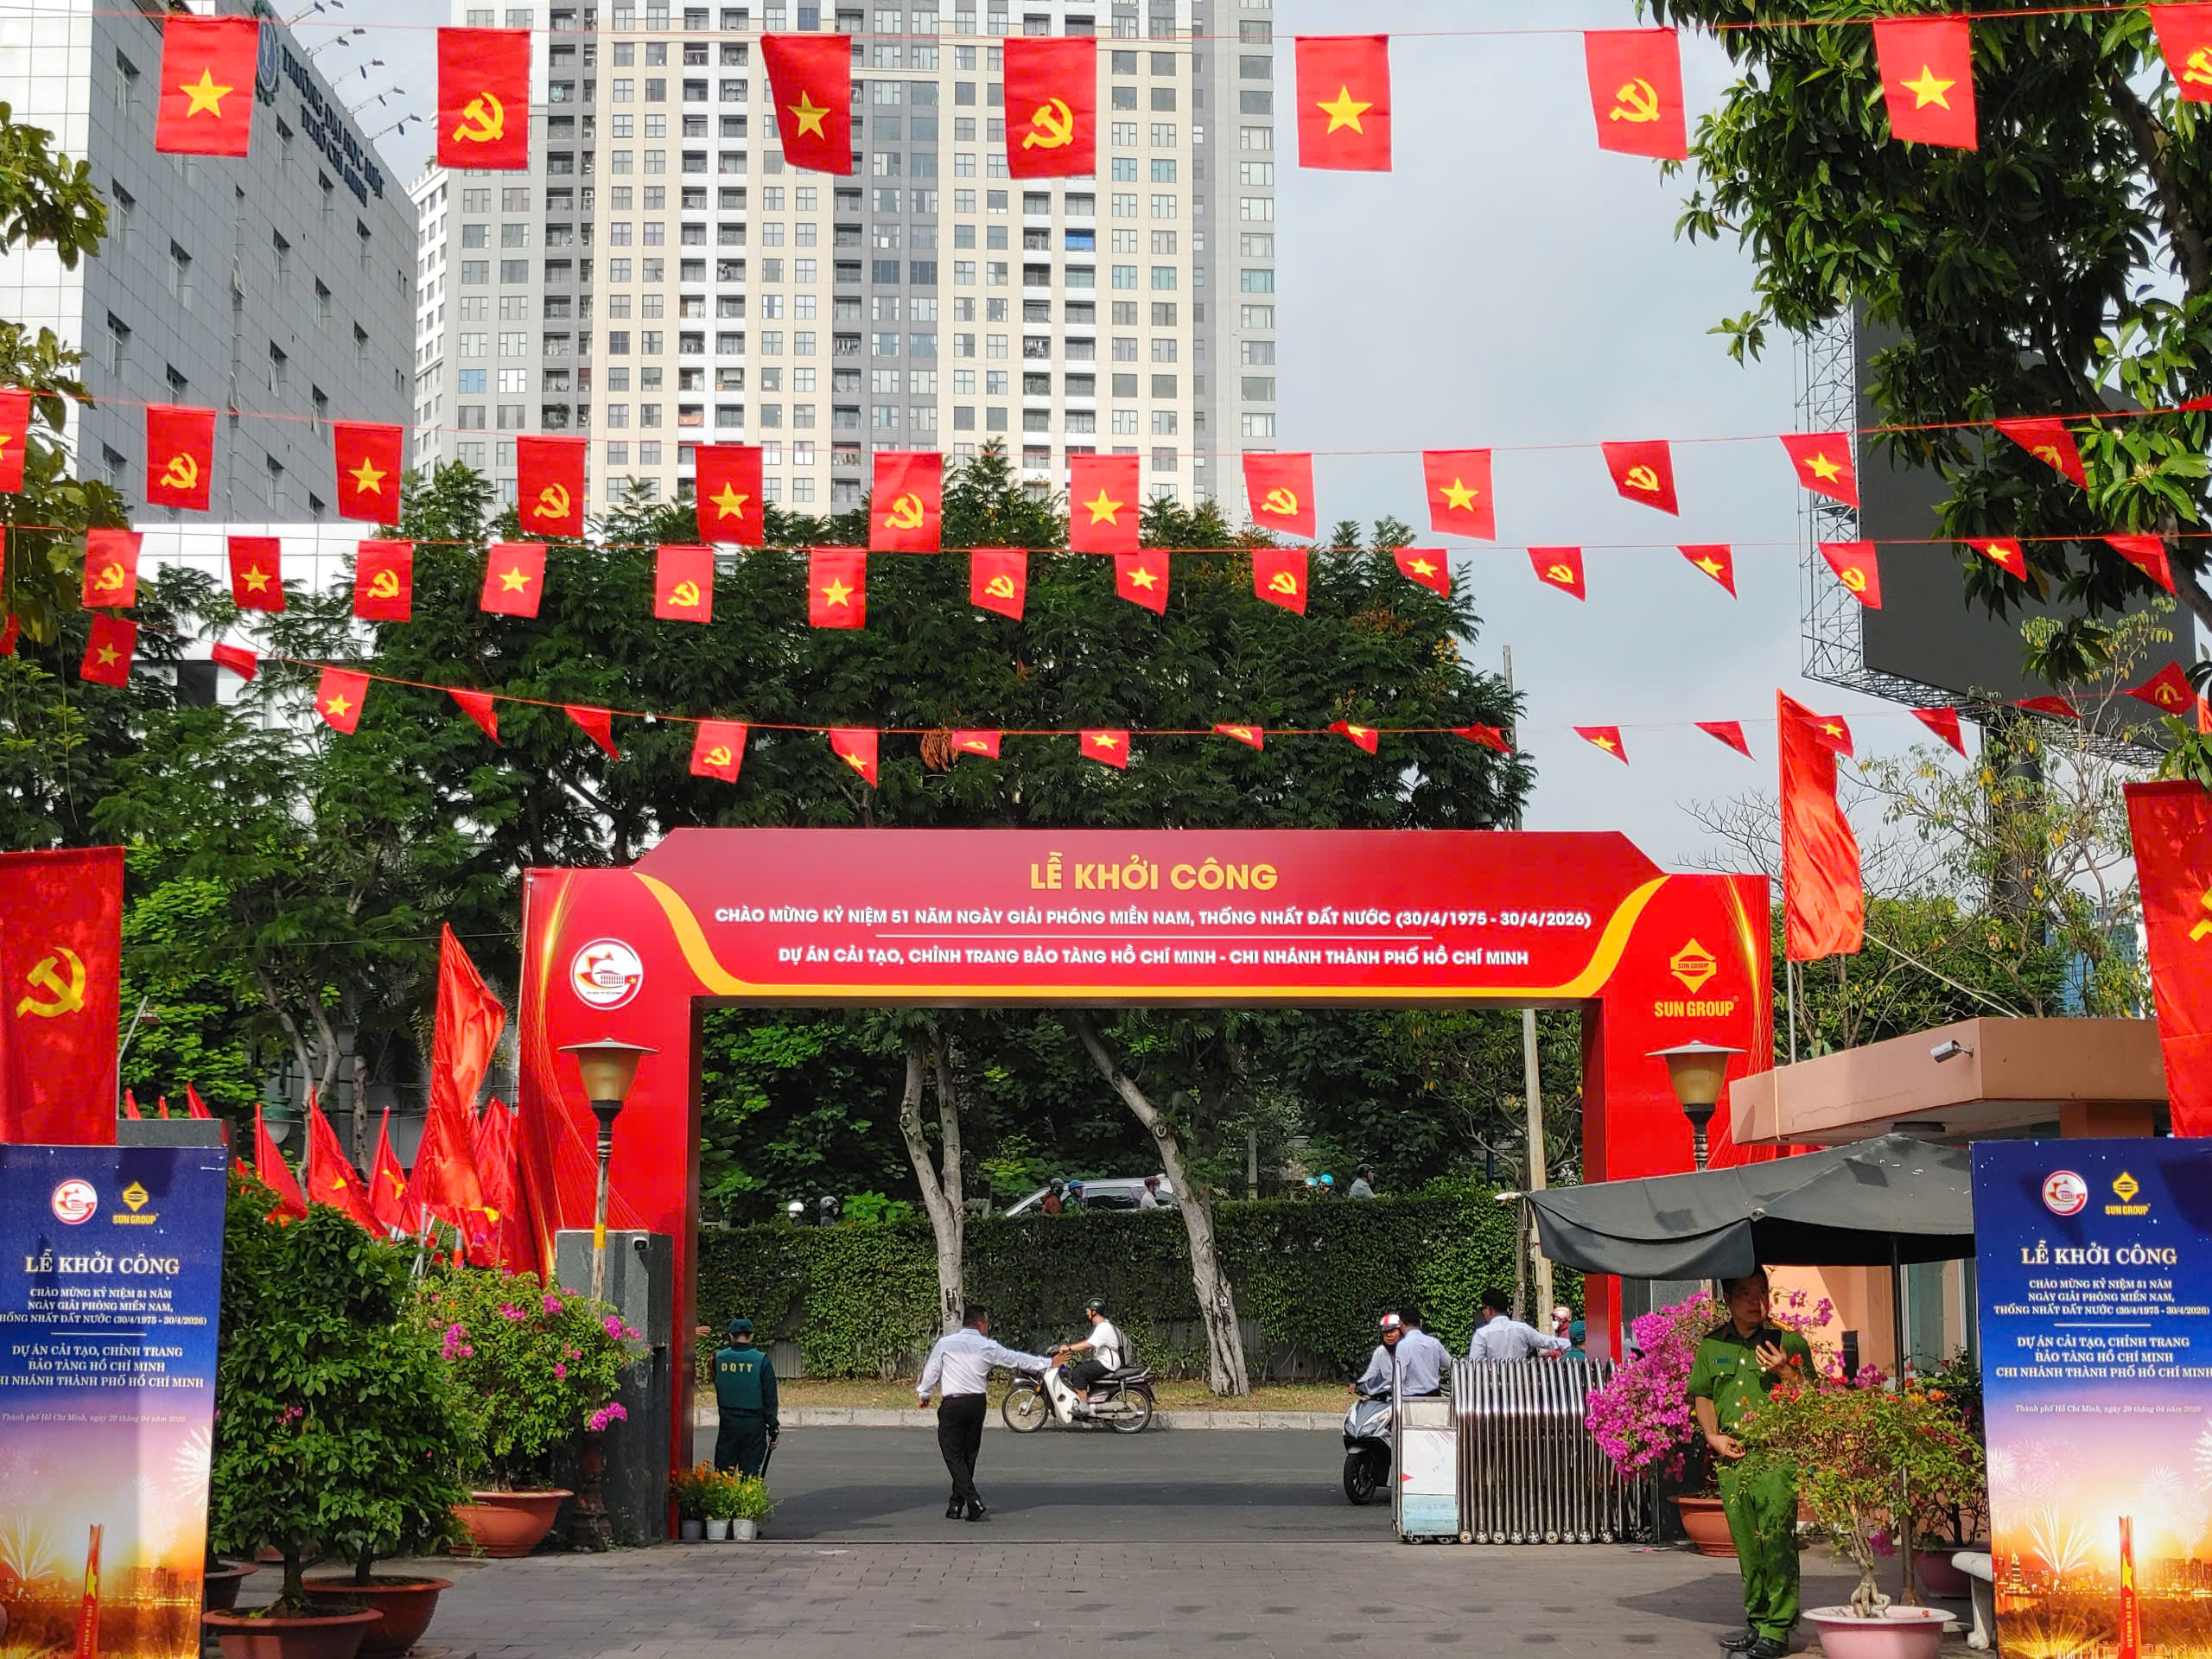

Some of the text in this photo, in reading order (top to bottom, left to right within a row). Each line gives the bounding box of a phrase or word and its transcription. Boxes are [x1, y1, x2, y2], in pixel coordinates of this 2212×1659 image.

[1031, 851, 1278, 891] LỄ KHỞI CÔNG
[715, 906, 765, 922] CHÀO
[769, 906, 818, 923] MỪNG
[823, 905, 844, 923] KỶ
[849, 906, 887, 926] NIỆM
[892, 910, 908, 923] 51
[916, 908, 952, 924] NĂM
[957, 907, 1003, 924] NGÀY
[1007, 906, 1042, 924] GIẢI
[1046, 908, 1105, 925] PHÓNG
[1110, 906, 1148, 925] MIỀN
[1154, 911, 1195, 927] NAM,
[1199, 906, 1255, 925] THỐNG
[1261, 906, 1303, 925] NHẤT
[1308, 906, 1338, 925] ĐẤT
[1344, 908, 1391, 925] NƯỚC
[1500, 912, 1592, 929] 30/4/2026)
[779, 947, 803, 965] DỰ
[806, 946, 830, 963] ÁN
[834, 945, 862, 963] CẢI
[868, 949, 904, 966] TẠO,
[909, 945, 961, 963] CHỈNH
[966, 950, 1019, 963] TRANG
[1024, 945, 1058, 963] BẢO
[1063, 947, 1106, 963] TÀNG
[1112, 944, 1135, 963] HỒ
[1141, 947, 1170, 963] CHÍ
[1174, 950, 1216, 963] MINH
[1230, 950, 1258, 963] CHI
[1263, 948, 1320, 964] NHÁNH
[1326, 948, 1380, 964] THÀNH
[1384, 946, 1419, 964] PHỐ
[1424, 944, 1447, 964] HỒ
[1452, 948, 1482, 964] CHÍ
[1486, 951, 1529, 964] MINH
[1654, 1001, 1684, 1017] SUN
[2105, 1205, 2121, 1215] SUN
[113, 1215, 130, 1224] SUN
[2021, 1239, 2177, 1265] LỄ KHỞI CÔNG
[24, 1249, 180, 1274] LỄ KHỞI CÔNG
[2029, 1278, 2057, 1288] CHÀO
[2060, 1278, 2090, 1288] MỪNG
[2093, 1277, 2106, 1289] KỶ
[2108, 1278, 2134, 1291] NIỆM
[2149, 1279, 2172, 1289] NĂM
[30, 1287, 59, 1297] CHÀO
[60, 1287, 91, 1297] MỪNG
[93, 1287, 108, 1298] KỶ
[109, 1287, 135, 1299] NIỆM
[149, 1288, 172, 1299] NĂM
[2028, 1291, 2056, 1301] NGÀY
[2058, 1290, 2080, 1301] GIẢI
[2082, 1291, 2118, 1301] PHÓNG
[2149, 1293, 2175, 1303] NAM,
[28, 1300, 56, 1310] NGÀY
[57, 1299, 79, 1310] GIẢI
[81, 1300, 118, 1311] PHÓNG
[148, 1302, 173, 1313] NAM,
[1993, 1303, 2031, 1314] THỐNG
[2031, 1303, 2061, 1314] NHẤT
[2062, 1303, 2083, 1314] ĐẤT
[2085, 1304, 2113, 1315] NƯỚC
[0, 1311, 28, 1323] HỐNG
[30, 1312, 59, 1323] NHẤT
[60, 1312, 81, 1323] ĐẤT
[2017, 1334, 2190, 1350] DỰ ÁN CẢI TẠO, CHỈNH TRANG
[12, 1343, 183, 1357] DỰ ÁN CẢI TẠO, CHỈNH TRANG
[2035, 1349, 2173, 1363] BẢO TÀNG HỒ CHÍ MINH
[28, 1357, 165, 1372] BẢO TÀNG HỒ CHÍ MINH
[721, 1362, 753, 1373] DQTT
[1996, 1367, 2018, 1377] CHI
[2020, 1365, 2063, 1377] NHÁNH
[2065, 1365, 2107, 1377] THÀNH
[2110, 1364, 2135, 1377] PHỐ
[2138, 1364, 2156, 1377] HỒ
[2158, 1365, 2179, 1377] CHÍ
[12, 1374, 54, 1386] NHÁNH
[56, 1374, 97, 1386] THÀNH
[101, 1374, 125, 1386] PHỐ
[129, 1373, 146, 1387] HỒ
[148, 1375, 169, 1387] CHÍ
[172, 1377, 204, 1388] MINH
